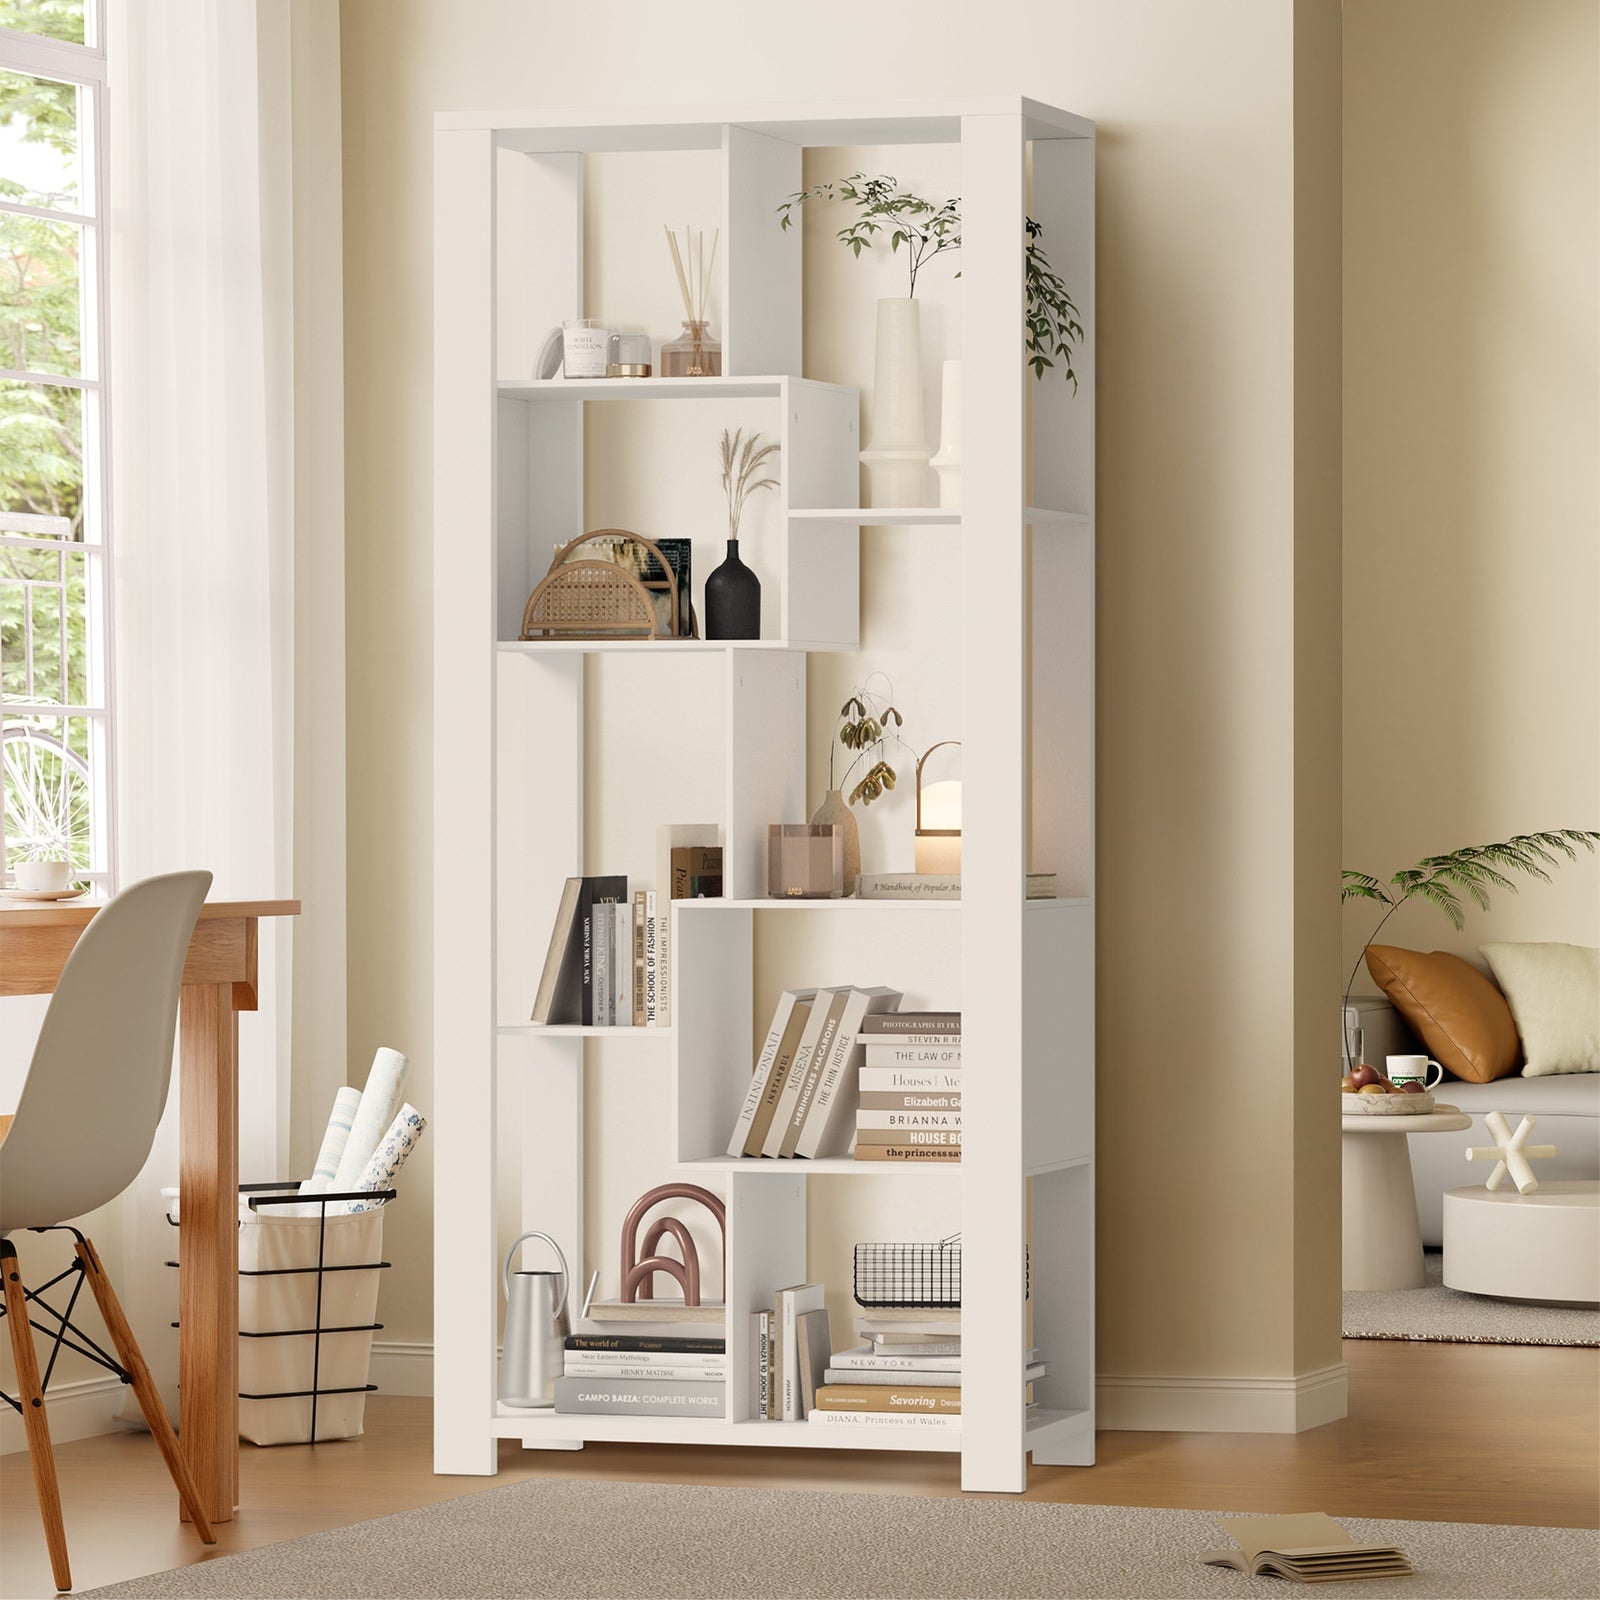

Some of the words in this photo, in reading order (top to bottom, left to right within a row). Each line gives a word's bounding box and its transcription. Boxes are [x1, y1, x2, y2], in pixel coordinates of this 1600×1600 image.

[872, 882, 879, 892] A
[880, 882, 913, 893] Handbook
[914, 882, 923, 893] of
[923, 882, 949, 893] Popular
[647, 917, 656, 954] FASHION
[596, 946, 606, 975] KING
[647, 956, 656, 967] OF
[647, 968, 656, 1004] SCHOOL
[647, 1005, 656, 1022] THE
[882, 1021, 936, 1029] PHOTOGRAPHS
[895, 1051, 914, 1060] THE
[918, 1051, 938, 1061] LAW
[941, 1052, 954, 1061] OF
[794, 1072, 816, 1126] MERINGUES
[815, 1018, 836, 1071] MACARONS
[818, 1086, 830, 1106] THE
[824, 1066, 838, 1089] THIN
[832, 1034, 850, 1068] JUSTICE
[766, 1054, 790, 1105] INSTANBUL
[893, 1074, 932, 1086] Houses
[904, 1096, 948, 1107] Elizabeth
[889, 1115, 948, 1125] BRIANNA
[910, 1132, 946, 1144] HOUSE
[886, 1148, 903, 1157] the
[904, 1148, 947, 1159] princess
[575, 1339, 588, 1347] The
[610, 1340, 620, 1348] of
[620, 1354, 650, 1362] Mythology
[850, 1359, 876, 1367] NEW
[883, 1360, 914, 1368] YORK
[578, 1393, 610, 1402] CAMPO
[612, 1394, 641, 1403] BAEZA:
[642, 1395, 687, 1404] COMPLETE
[688, 1396, 718, 1406] WORKS
[890, 1394, 936, 1408] Savoring
[865, 1416, 904, 1425] Princess
[907, 1417, 917, 1425] of
[920, 1418, 947, 1426] Wales
